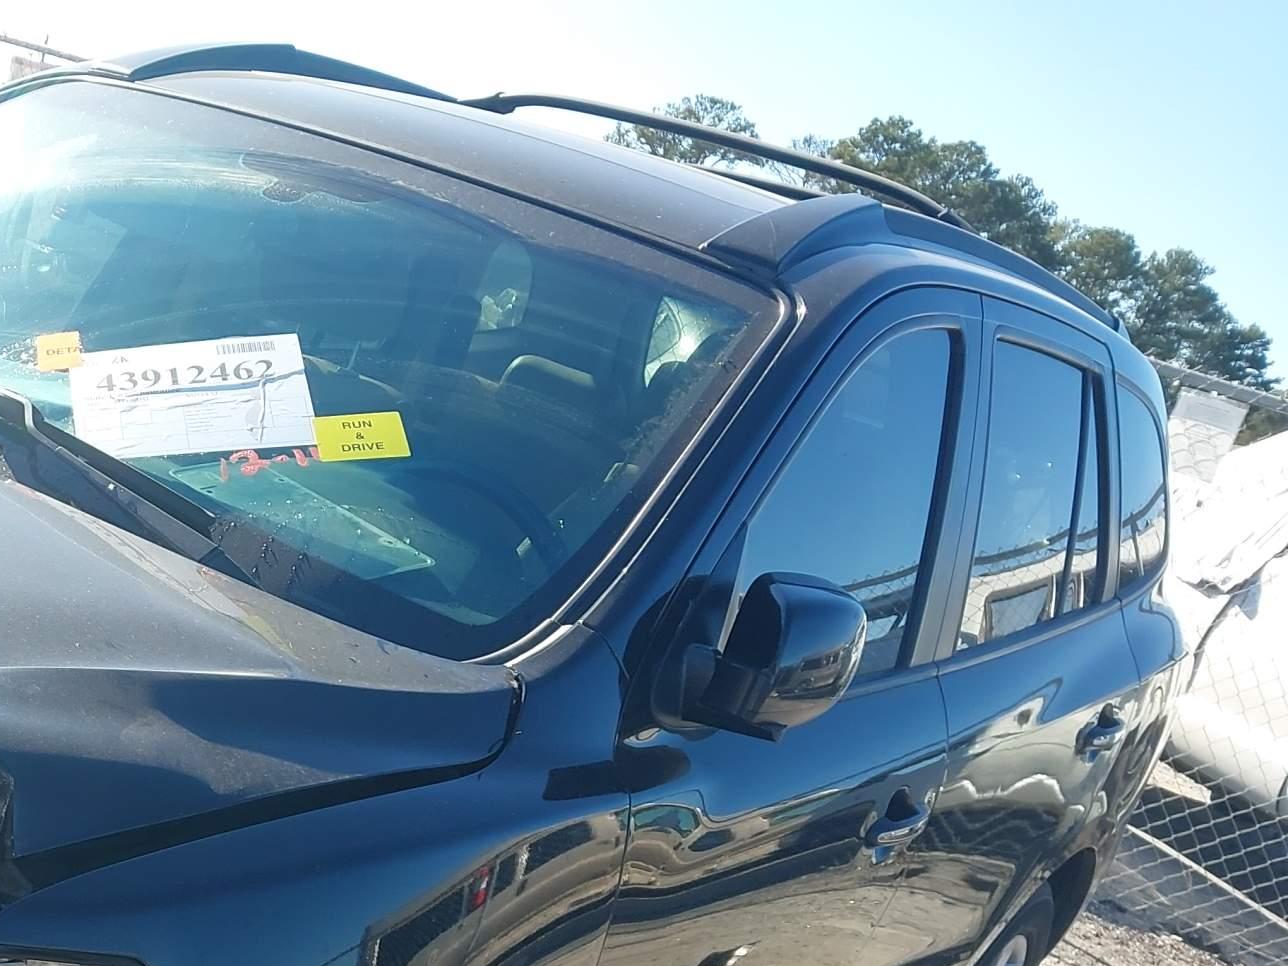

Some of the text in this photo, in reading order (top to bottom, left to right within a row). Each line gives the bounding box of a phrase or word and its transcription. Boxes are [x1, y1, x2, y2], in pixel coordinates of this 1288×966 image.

[96, 360, 275, 392] 43912462
[342, 420, 372, 430] RUN
[355, 431, 364, 440] &
[342, 442, 385, 452] DRIVE
